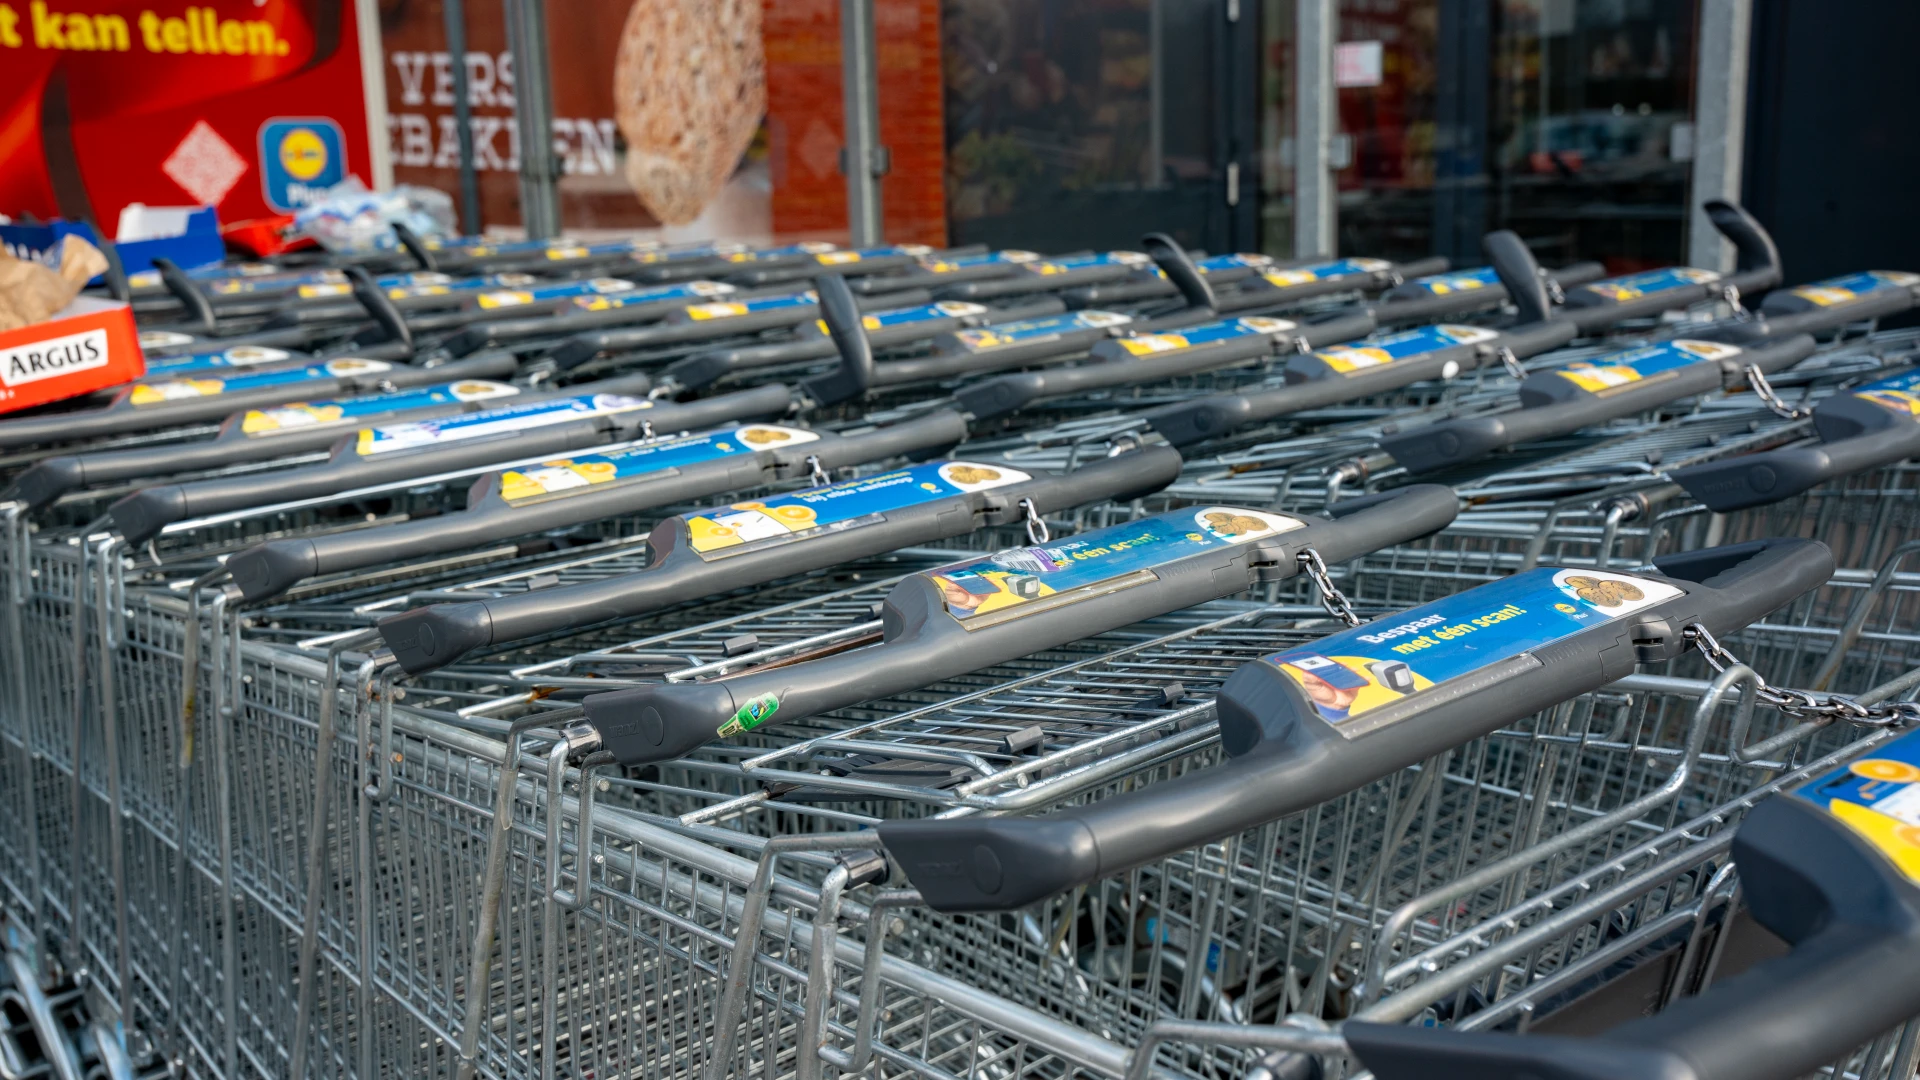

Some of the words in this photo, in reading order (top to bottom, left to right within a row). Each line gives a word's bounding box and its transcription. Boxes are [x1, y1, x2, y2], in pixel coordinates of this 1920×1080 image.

[30, 1, 131, 50] kan
[138, 7, 290, 56] tellen.
[392, 50, 517, 108] VERS
[9, 337, 100, 379] ARGUS
[1356, 613, 1447, 644] Bespaar
[1391, 635, 1441, 655] met
[1431, 625, 1479, 640] één
[1471, 603, 1528, 628] scan!
